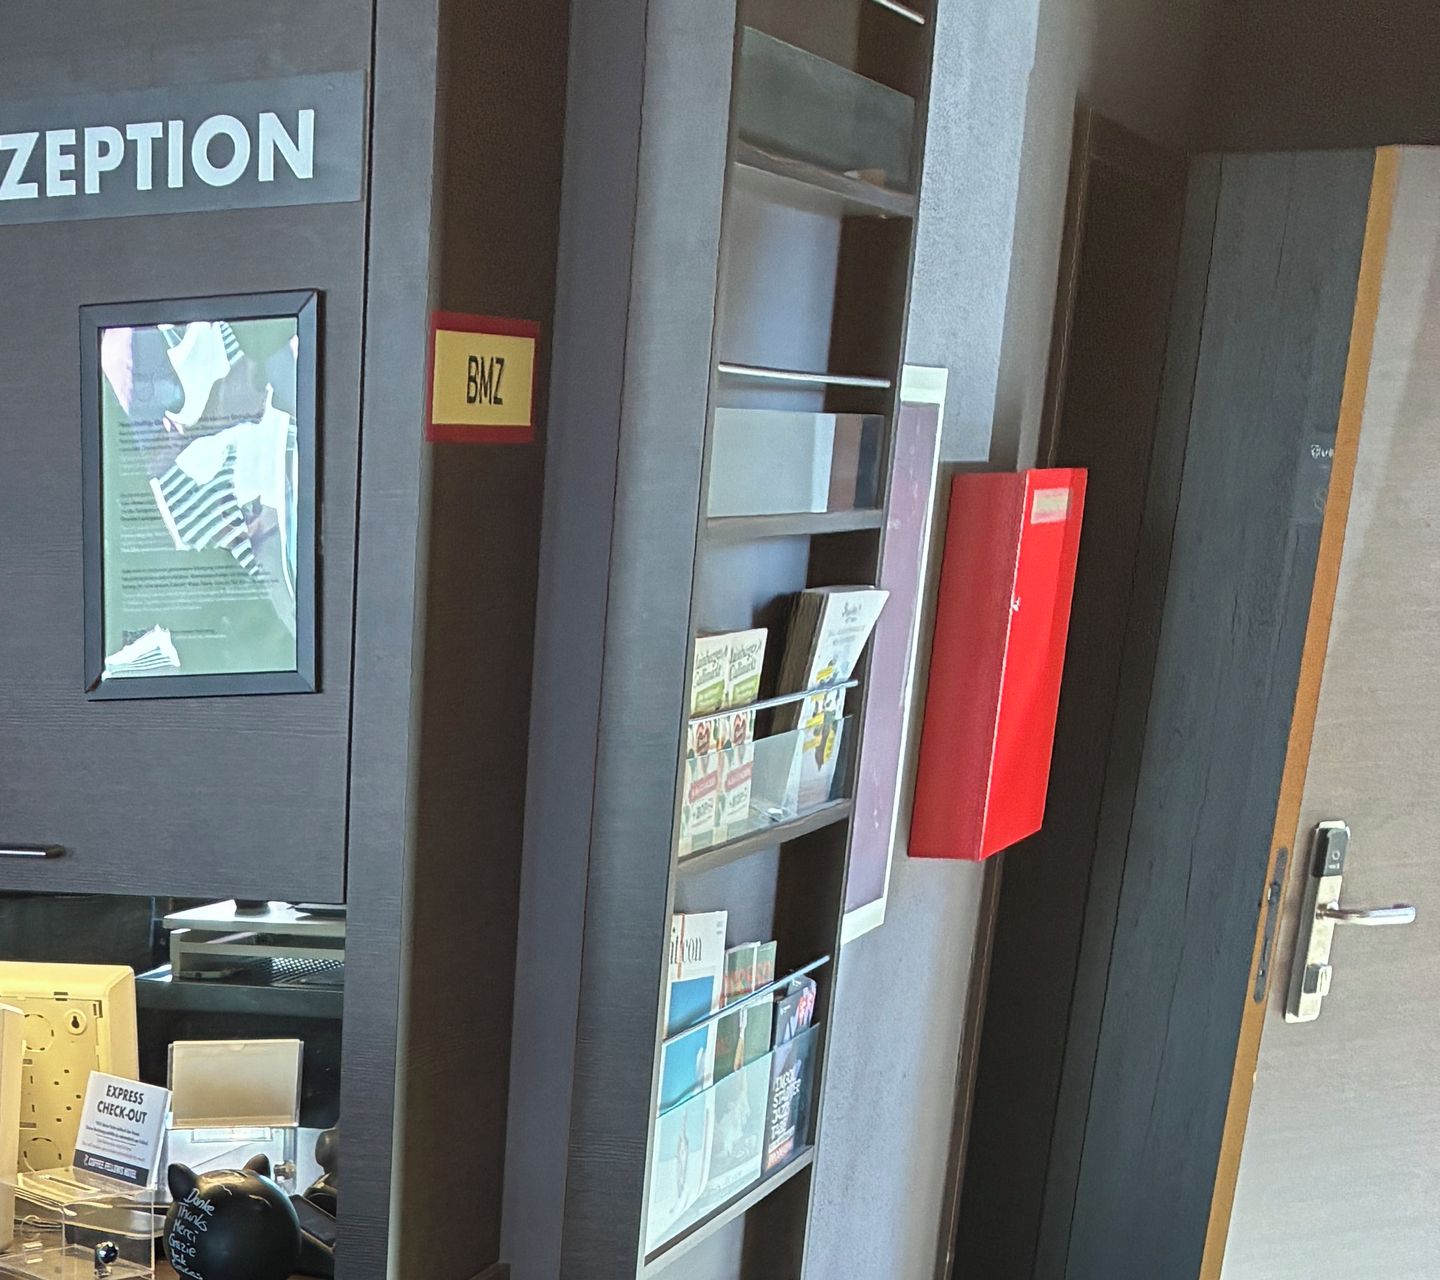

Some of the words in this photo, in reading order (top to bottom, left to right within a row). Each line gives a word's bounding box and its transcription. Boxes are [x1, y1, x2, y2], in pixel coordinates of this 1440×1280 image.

[466, 355, 505, 406] BMZ
[106, 1085, 144, 1105] EXPRESS
[97, 1101, 147, 1124] CHECK-OUT
[183, 1188, 215, 1216] Danke
[173, 1218, 199, 1243] Merci
